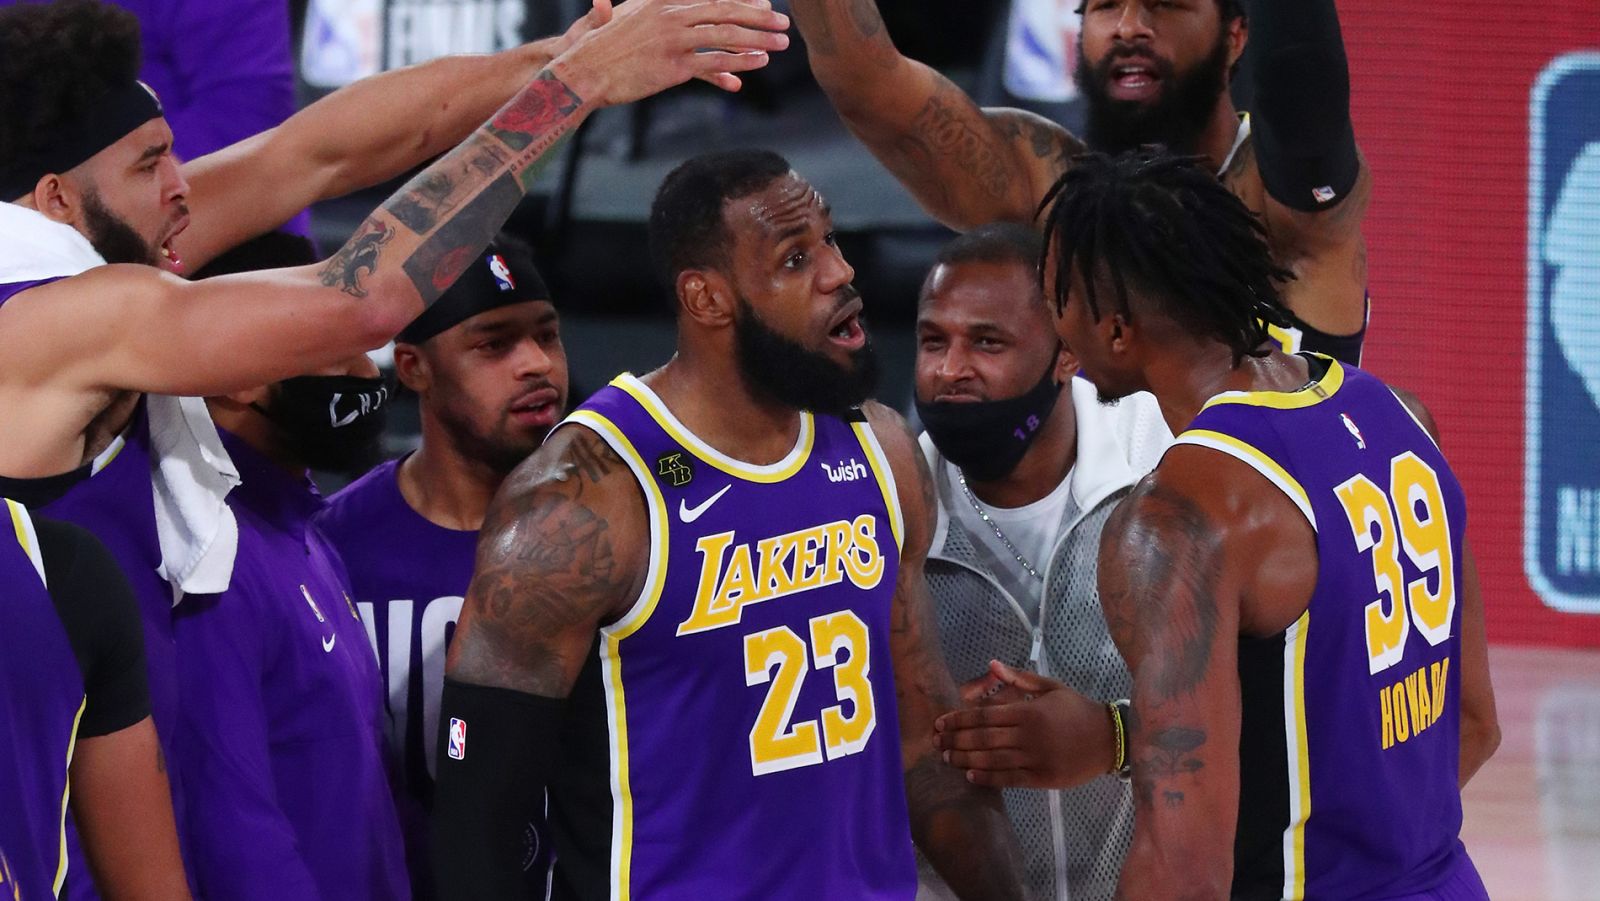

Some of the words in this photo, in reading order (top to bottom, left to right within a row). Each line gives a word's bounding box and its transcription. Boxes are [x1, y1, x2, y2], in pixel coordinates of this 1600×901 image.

[821, 458, 867, 482] wish
[1013, 414, 1040, 440] 18
[676, 514, 885, 637] LAKERS
[1332, 450, 1456, 676] 39
[743, 609, 877, 777] 23
